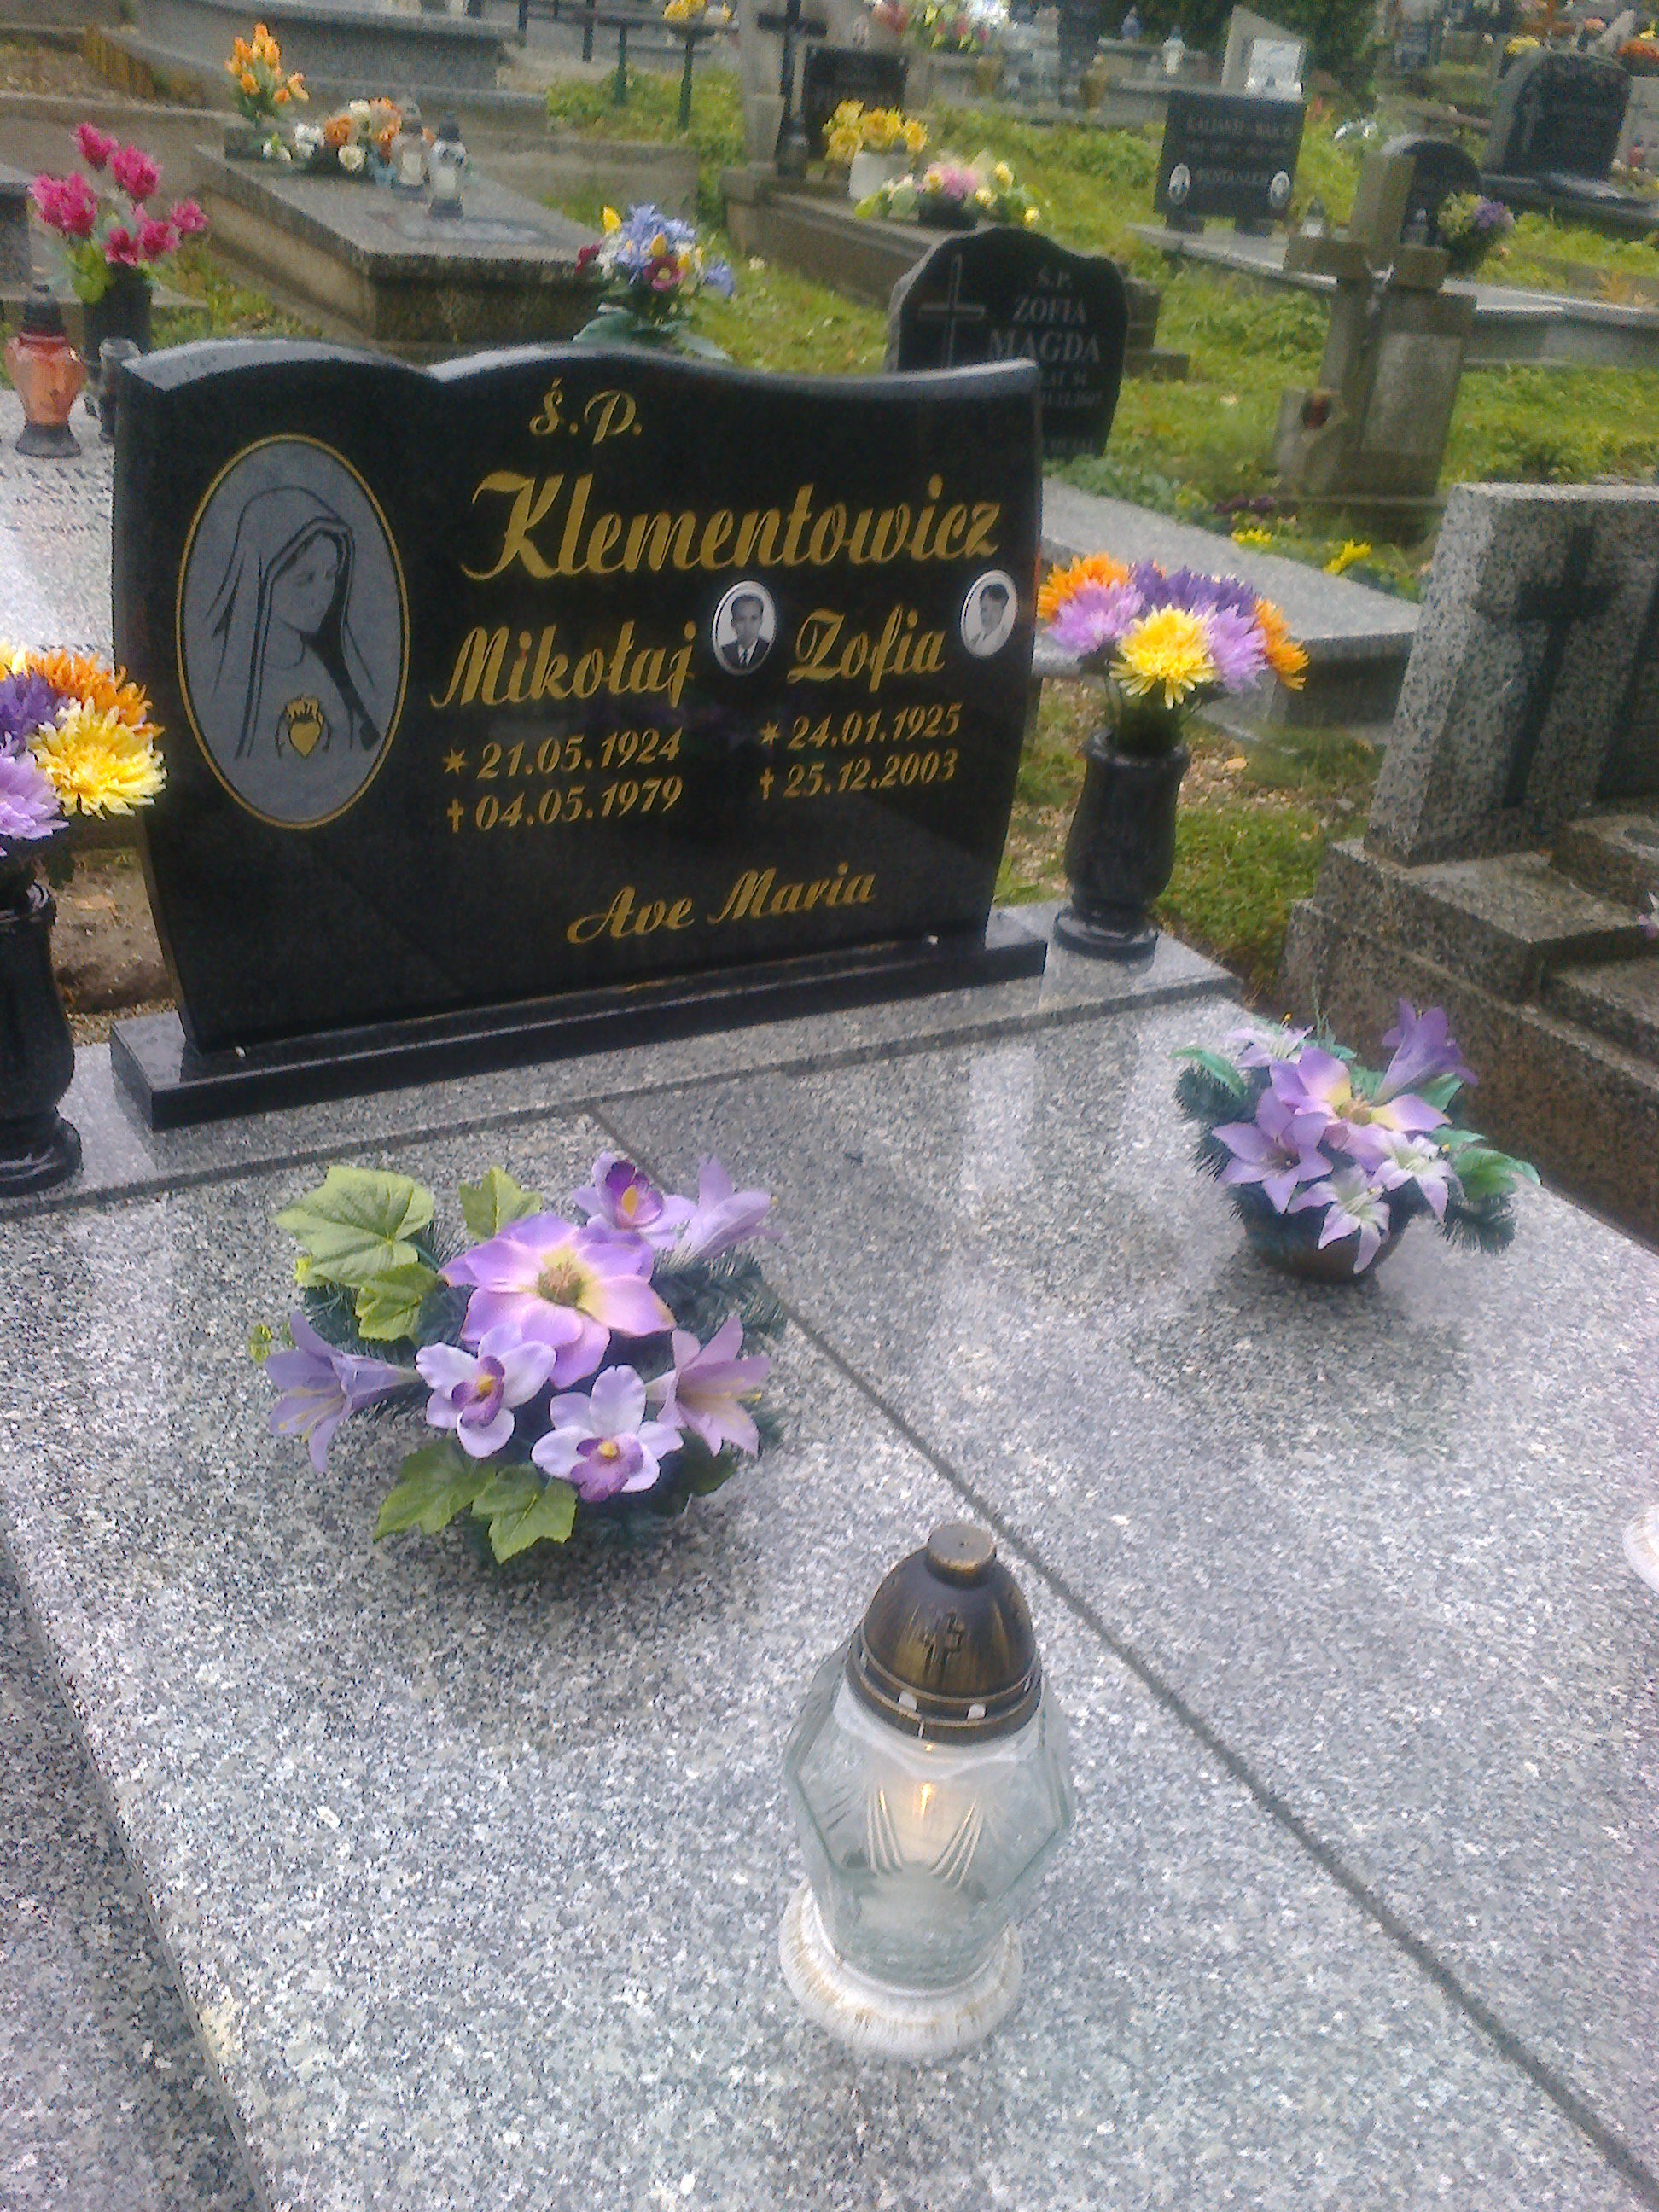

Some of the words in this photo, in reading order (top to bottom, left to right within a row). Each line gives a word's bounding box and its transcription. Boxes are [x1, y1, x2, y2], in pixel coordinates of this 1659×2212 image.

[987, 328, 1101, 363] MAGDA
[1012, 295, 1087, 323] ZOFIA
[461, 470, 1002, 581] Klementowicz
[429, 619, 696, 709] Mikołaj
[786, 603, 946, 693] Zofia
[475, 726, 683, 778] 21.05.1924
[786, 702, 963, 751] 24.01.1925
[474, 776, 683, 832] 04.05.1979
[783, 748, 958, 799] 25.12.2003
[707, 862, 876, 924] Maria
